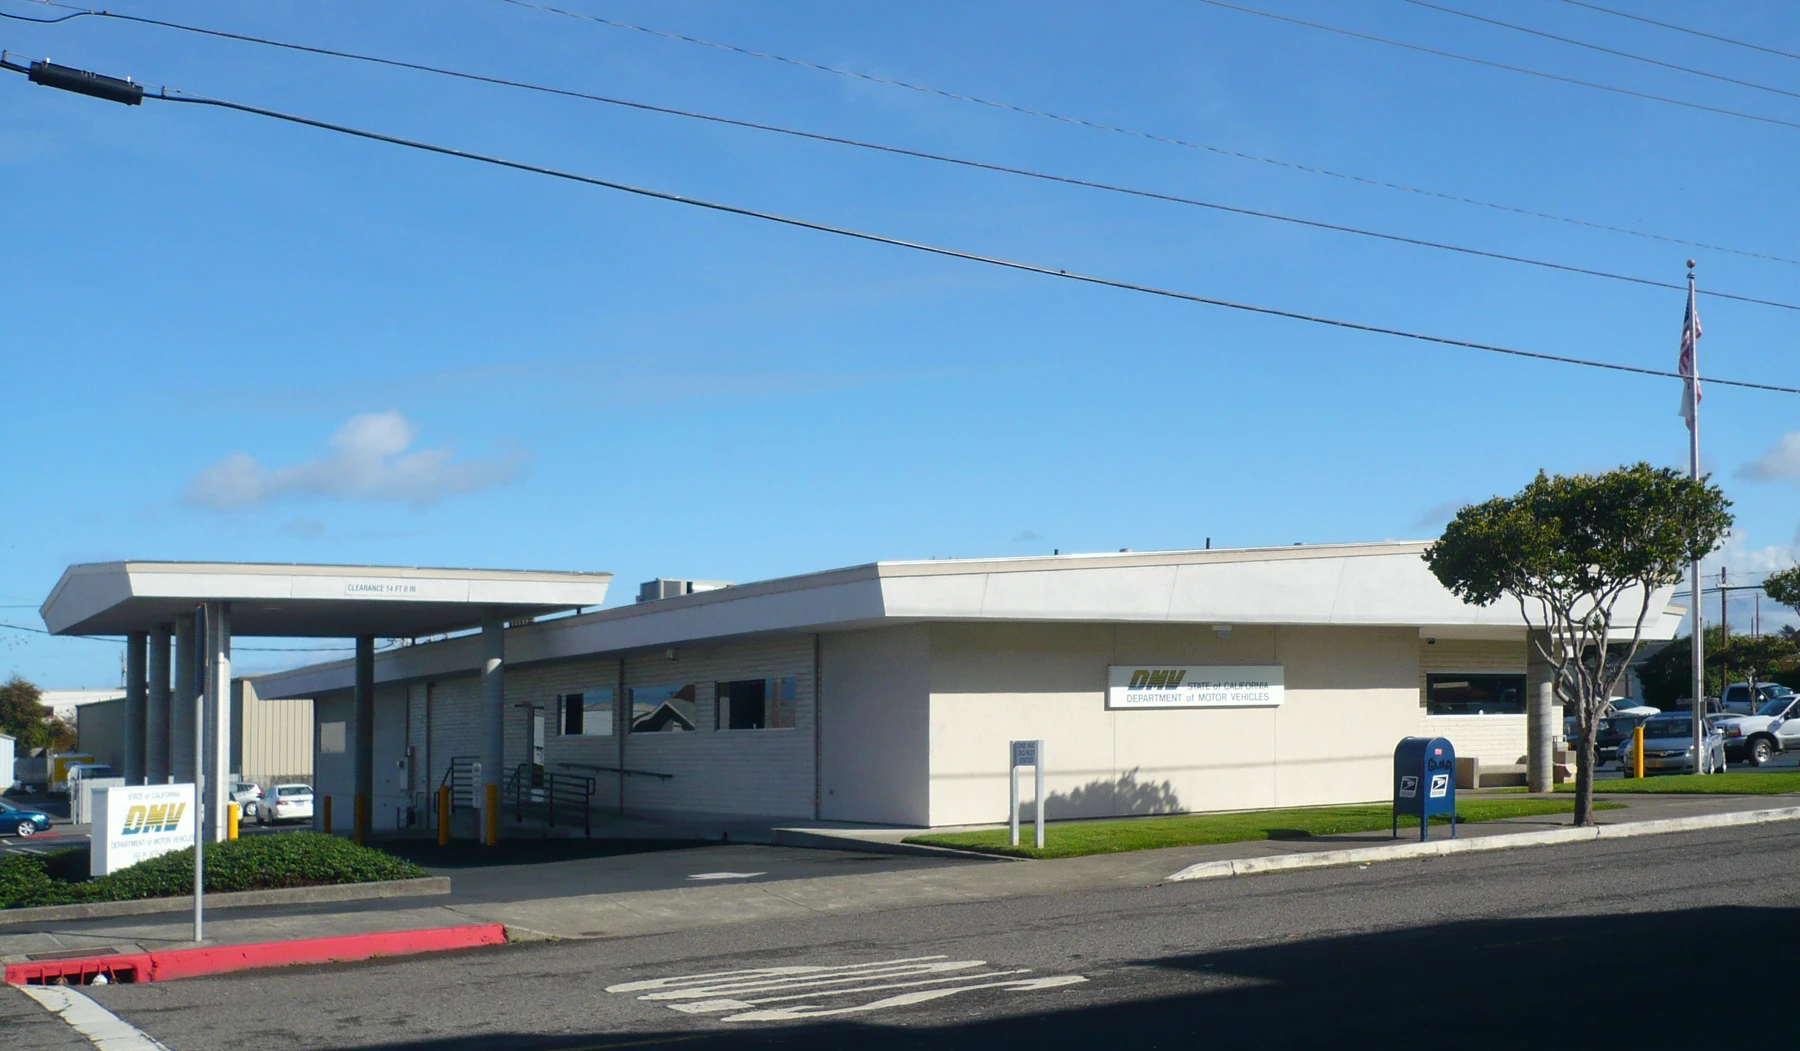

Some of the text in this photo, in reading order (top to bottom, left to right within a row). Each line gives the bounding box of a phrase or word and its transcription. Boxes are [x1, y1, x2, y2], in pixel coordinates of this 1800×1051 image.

[347, 584, 384, 592] CLEARANCE
[409, 585, 417, 593] IN
[1128, 670, 1186, 691] DMV
[1187, 682, 1269, 690] STATE of CALIFORNIA
[1126, 692, 1269, 703] DEPARTMENT of MOTOR VEHICLES
[128, 792, 143, 800] STATE
[151, 791, 181, 799] CALIFORNIA
[121, 802, 187, 835] DMV
[110, 839, 145, 849] DEPARTMENT
[153, 837, 171, 845] MOTOR
[604, 955, 1090, 1021] STOP
